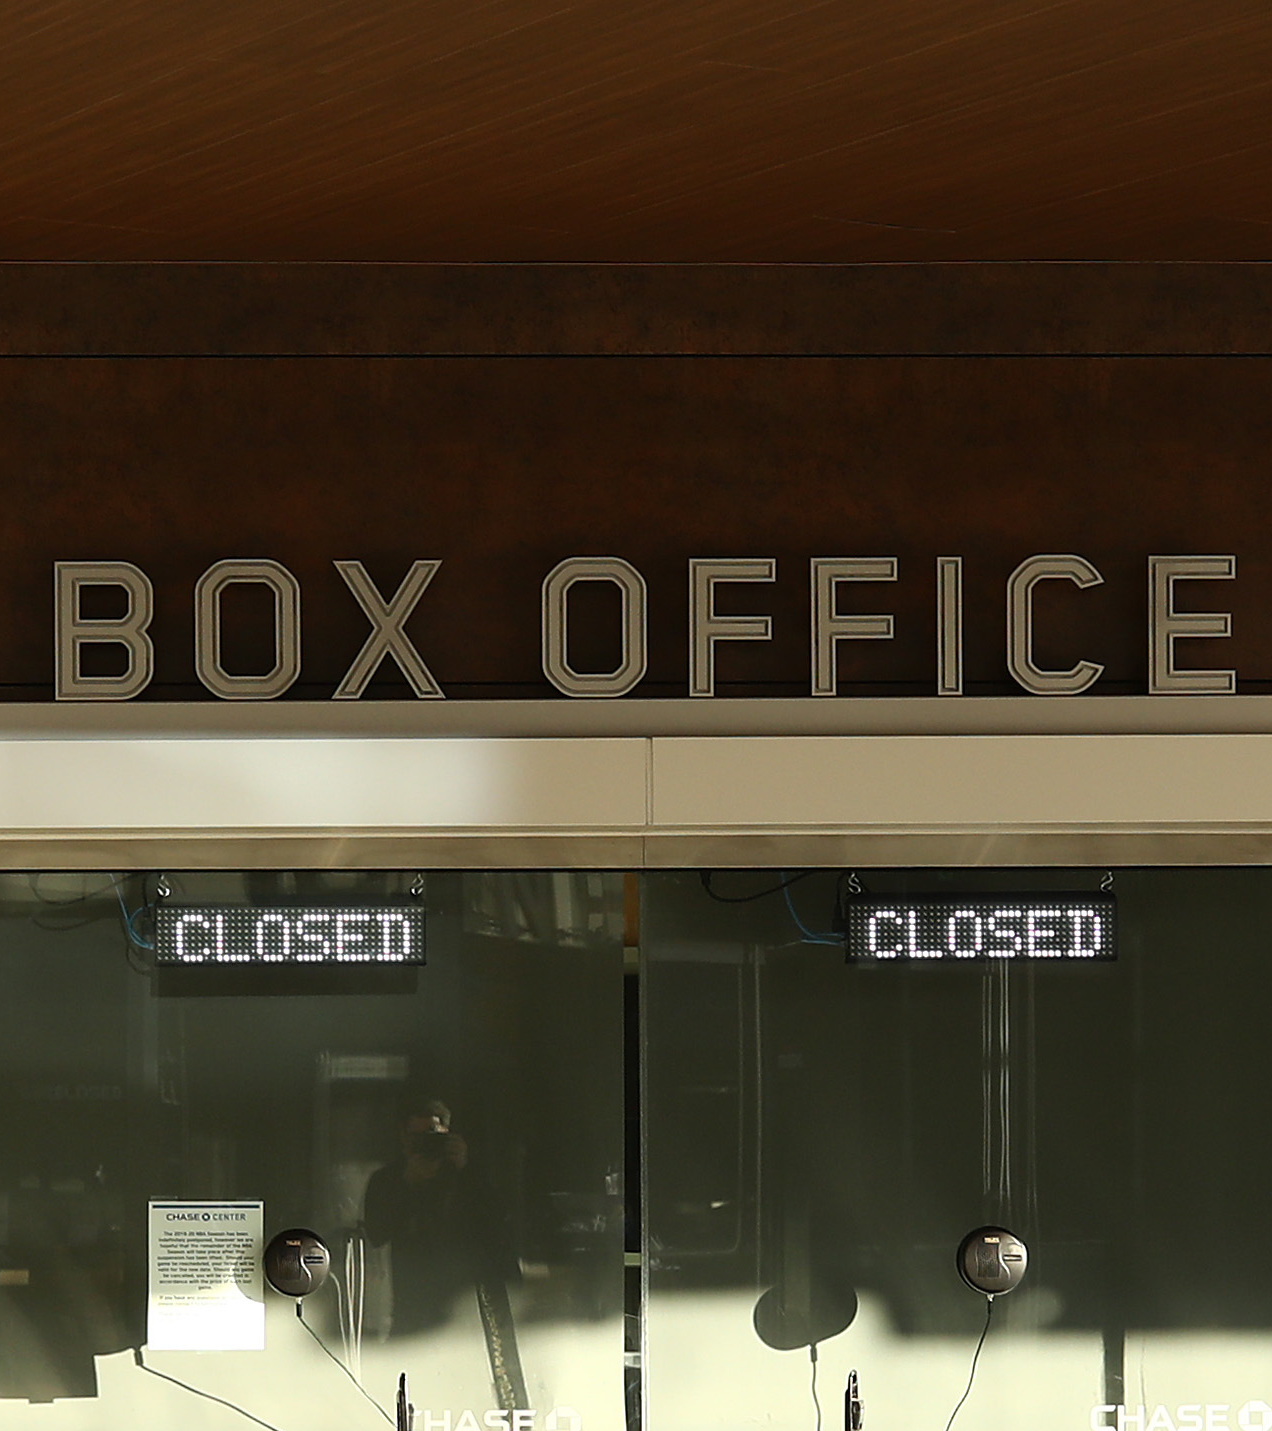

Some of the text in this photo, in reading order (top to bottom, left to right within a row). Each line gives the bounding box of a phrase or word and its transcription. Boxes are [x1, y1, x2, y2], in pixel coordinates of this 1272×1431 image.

[54, 554, 1236, 701] BOX OFFICE
[176, 913, 411, 962] CLOSED
[869, 909, 1101, 958] CLOSED
[166, 1213, 246, 1221] CHASE CENTER
